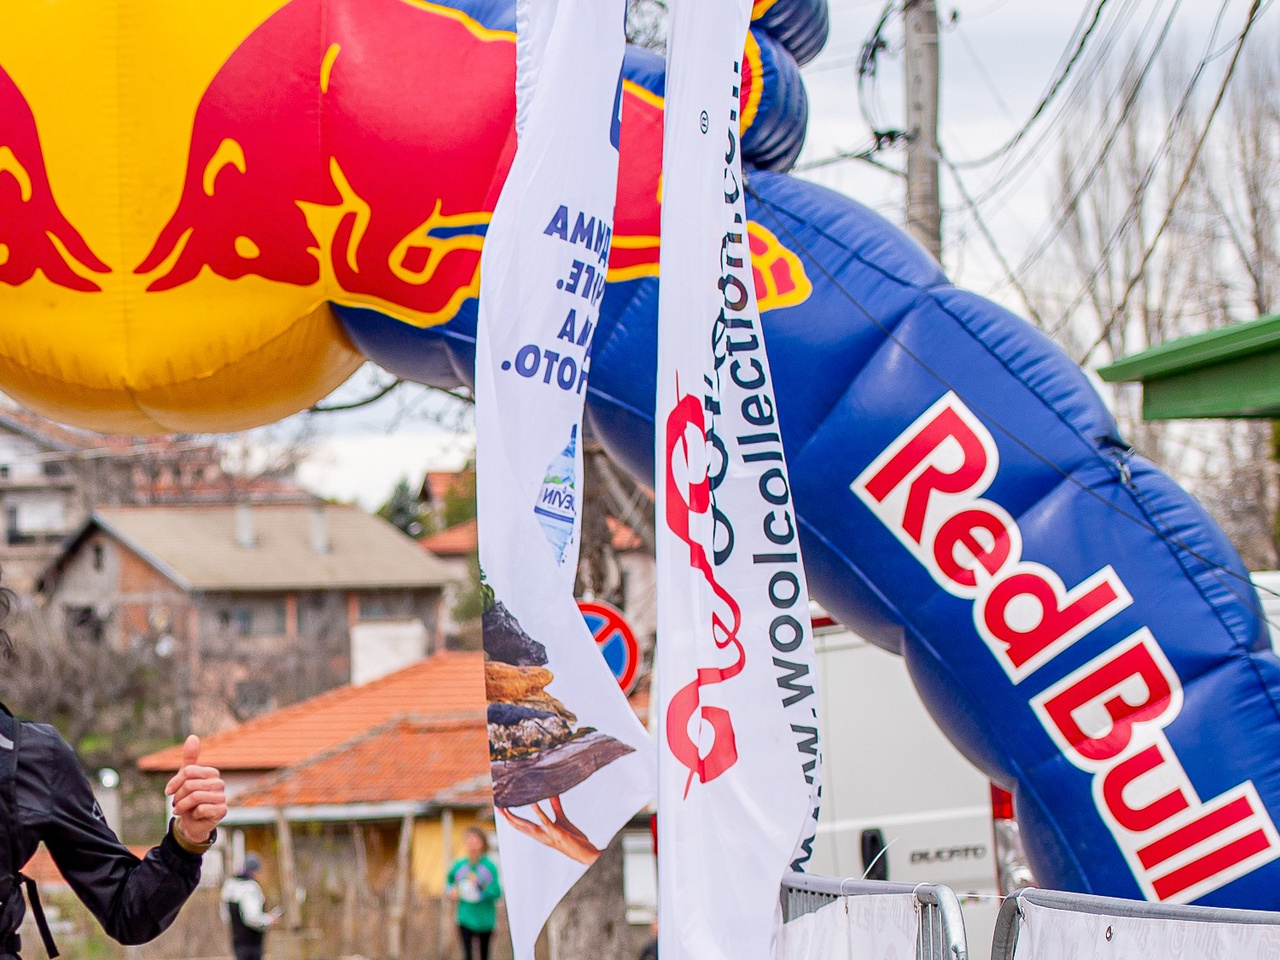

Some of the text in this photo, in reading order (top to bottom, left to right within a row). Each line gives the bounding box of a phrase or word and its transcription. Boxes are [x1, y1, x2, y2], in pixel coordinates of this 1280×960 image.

[858, 397, 1126, 677] Red
[1038, 634, 1278, 902] Bull
[911, 845, 986, 864] DUCATO
